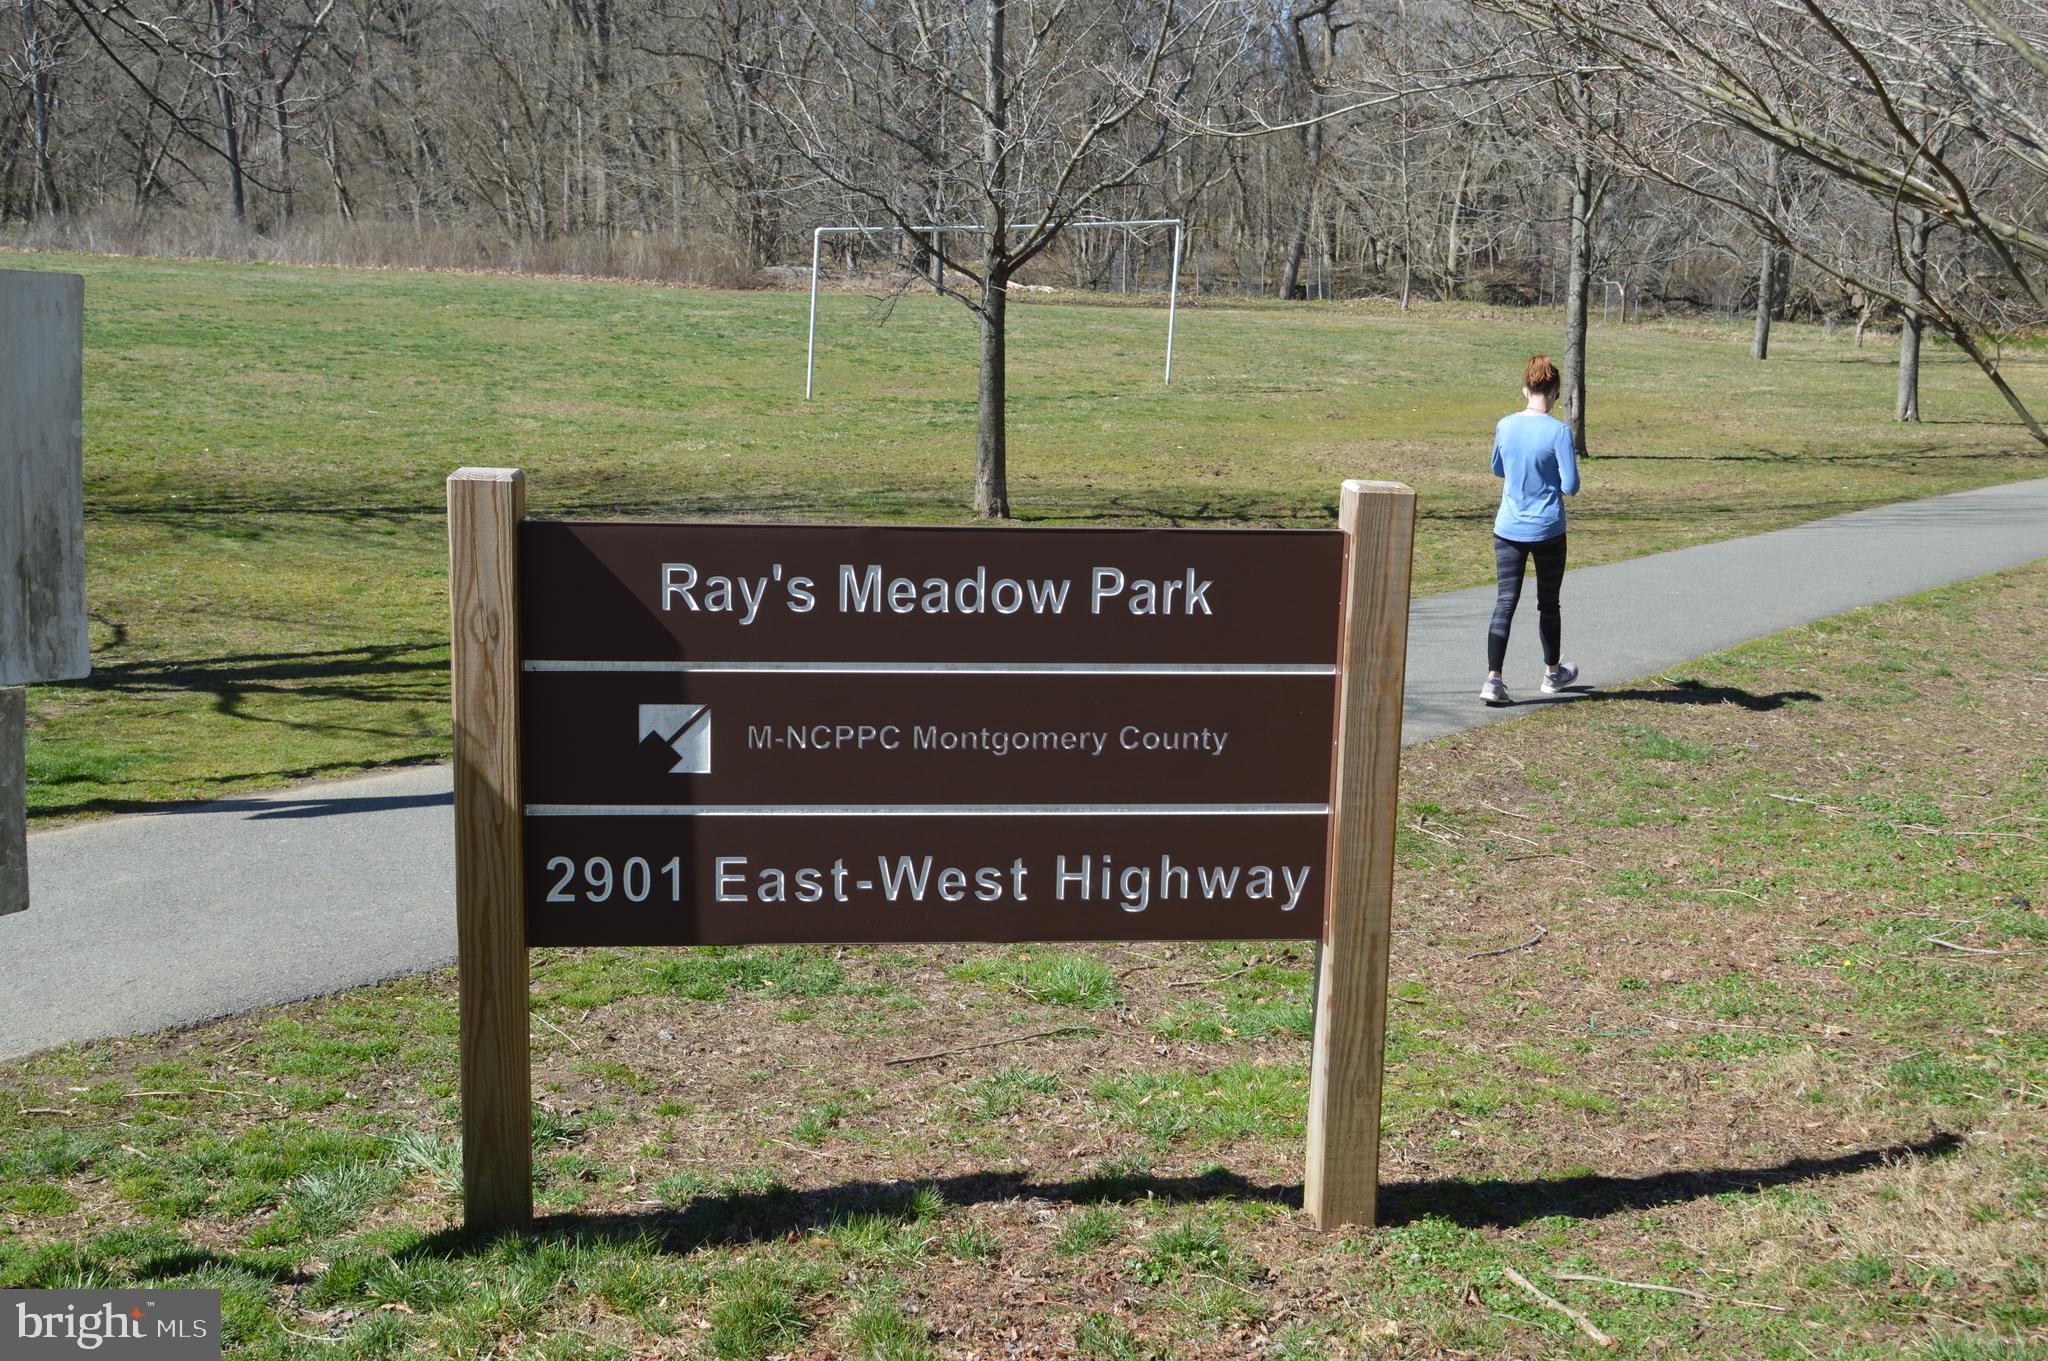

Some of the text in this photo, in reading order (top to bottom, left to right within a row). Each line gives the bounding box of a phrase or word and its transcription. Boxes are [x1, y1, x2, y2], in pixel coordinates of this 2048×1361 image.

[661, 562, 1214, 626] Ray's Meadow Park
[748, 725, 1228, 756] M-NCPPC Montgomery County
[545, 854, 1311, 913] 2901 East-West Highway
